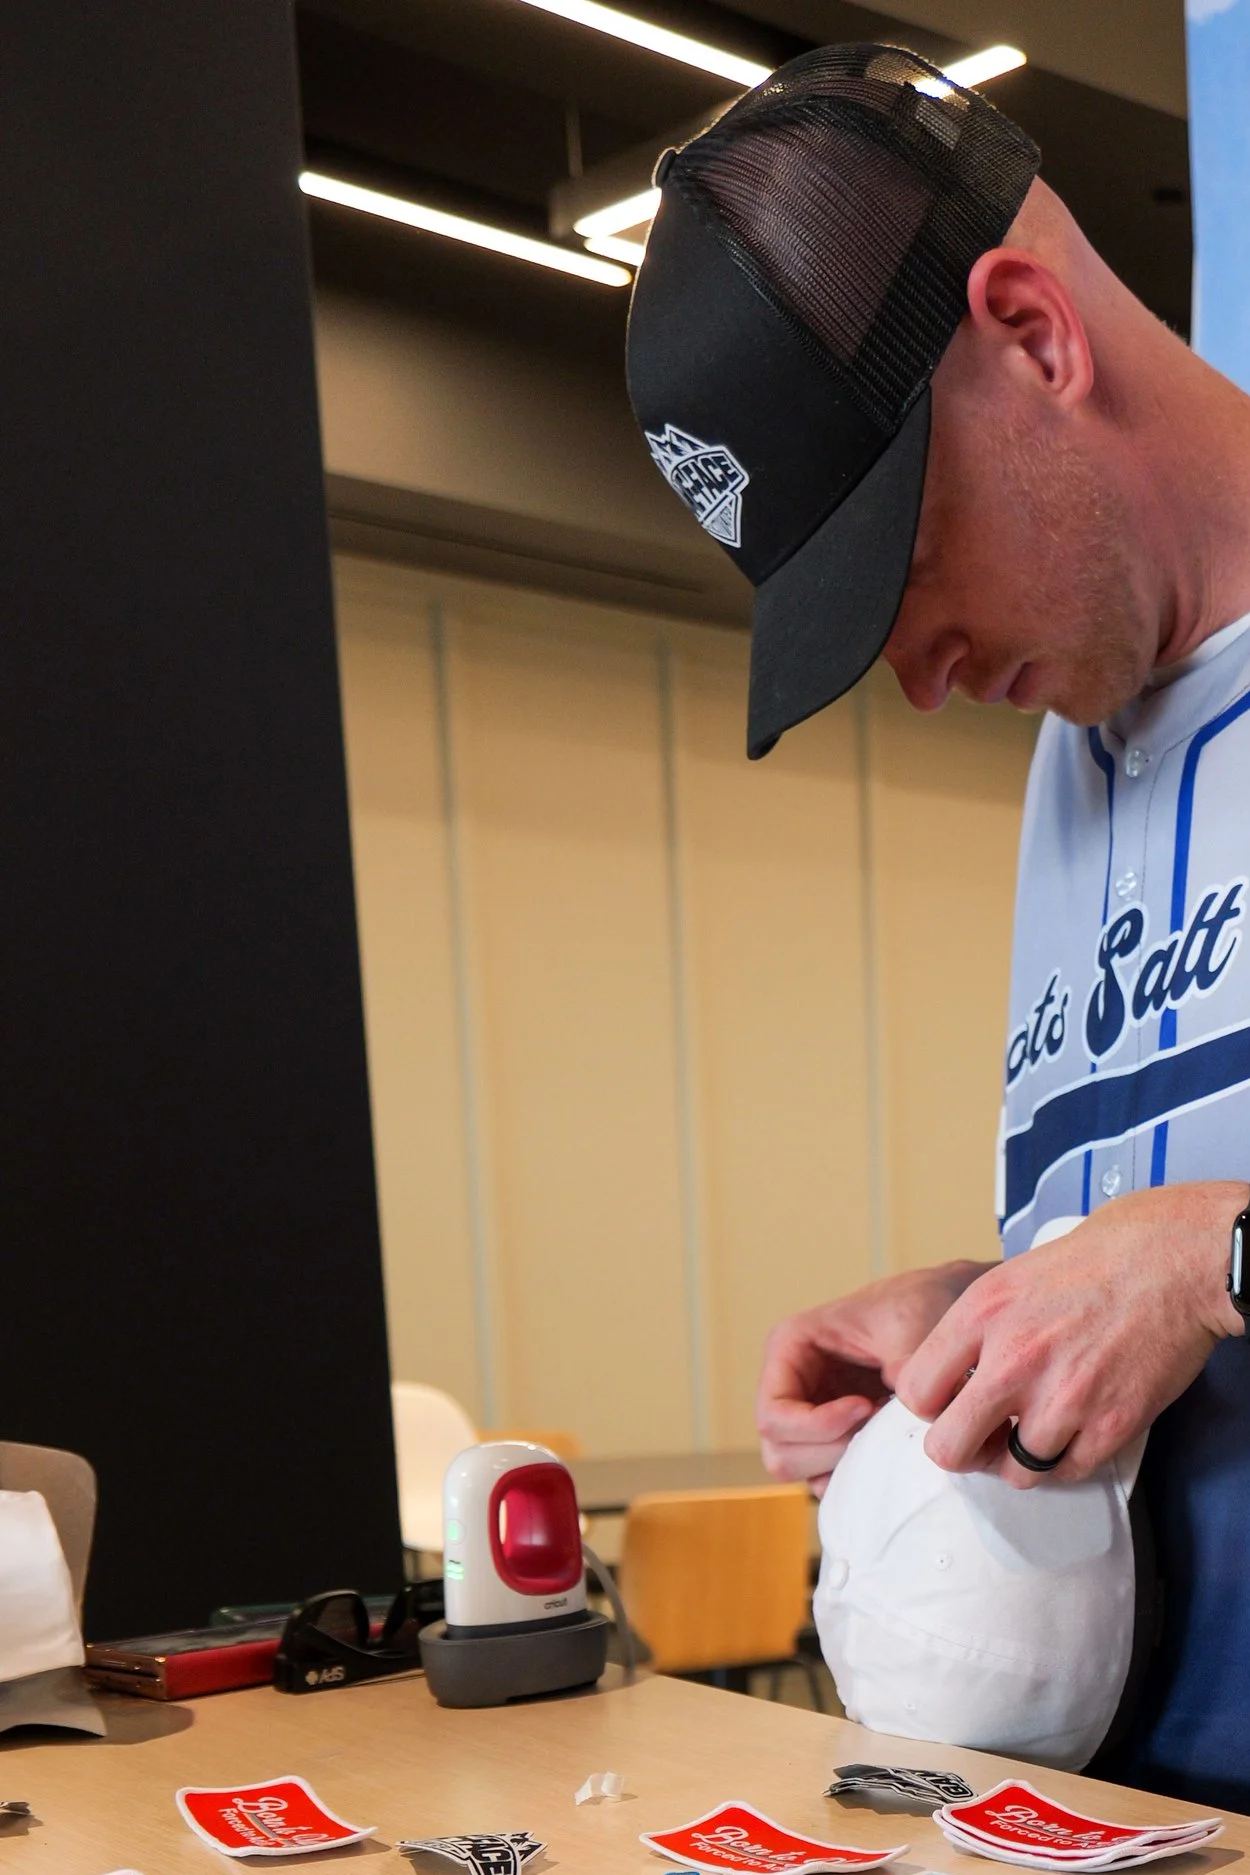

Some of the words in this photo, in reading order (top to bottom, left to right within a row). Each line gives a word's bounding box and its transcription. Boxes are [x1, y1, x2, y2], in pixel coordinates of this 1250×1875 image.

[1085, 880, 1240, 1058] Salt
[985, 1805, 1074, 1836] Born
[990, 1819, 1055, 1843] Forced
[689, 1841, 745, 1864] Forced
[691, 1826, 770, 1857] Born
